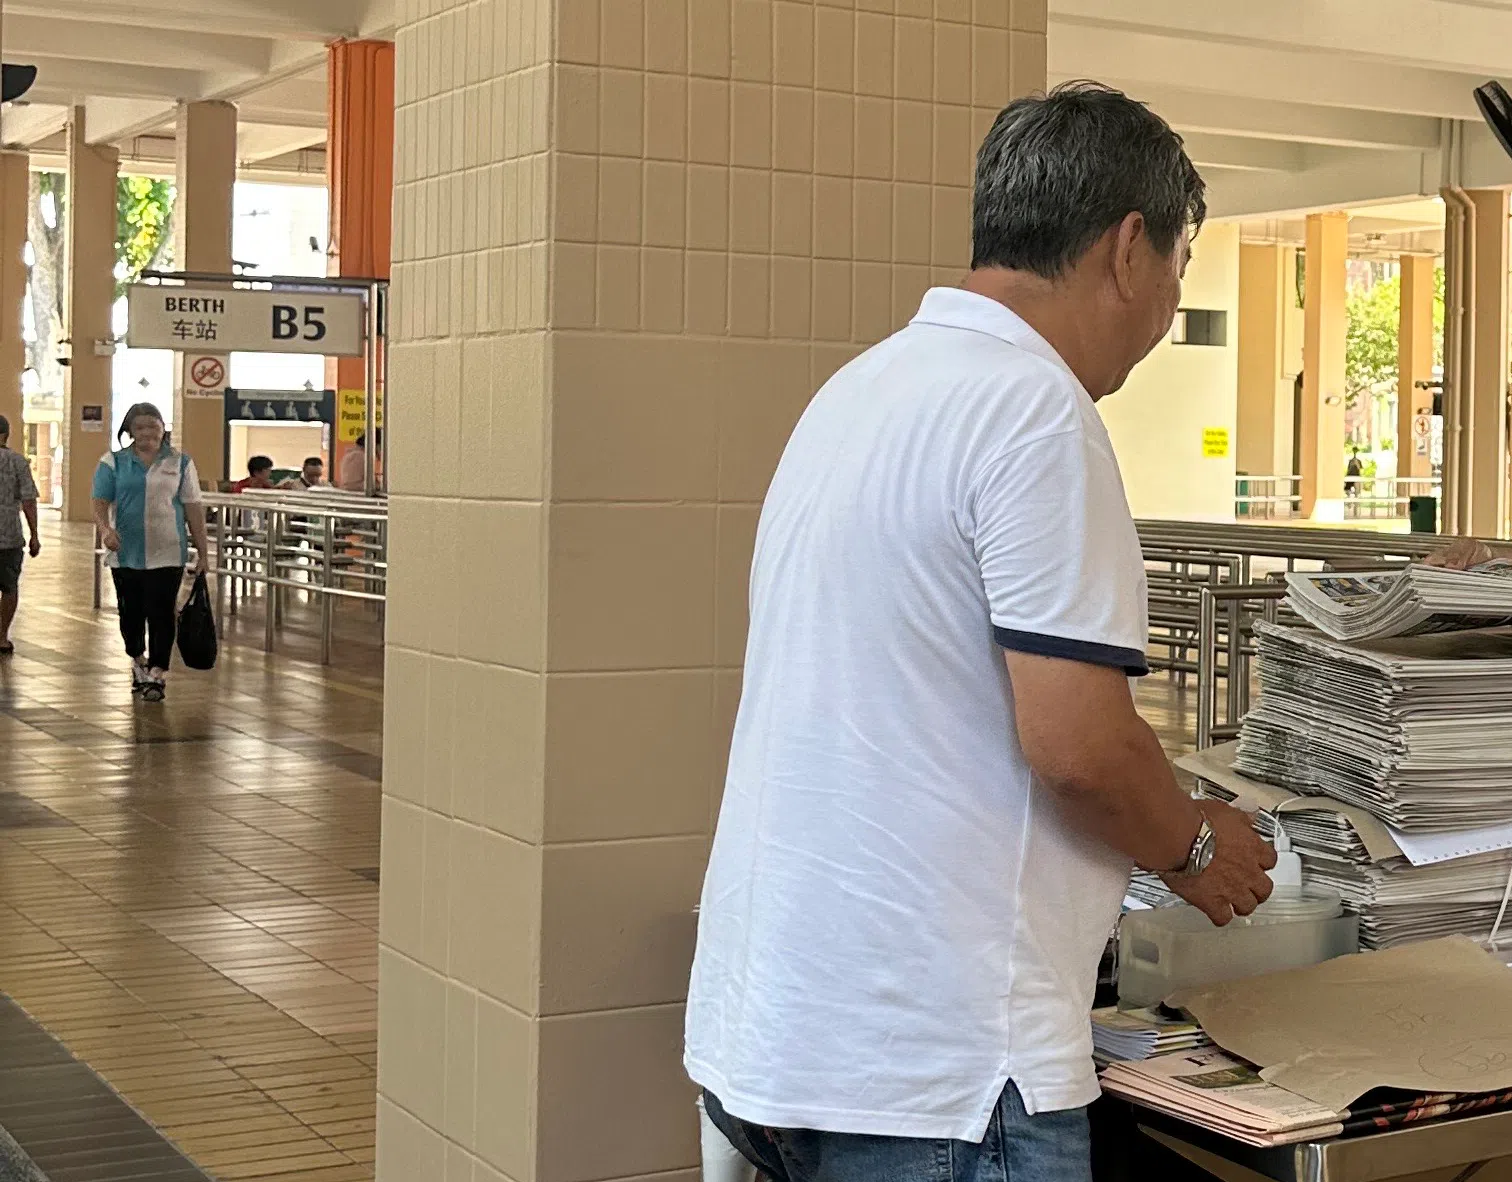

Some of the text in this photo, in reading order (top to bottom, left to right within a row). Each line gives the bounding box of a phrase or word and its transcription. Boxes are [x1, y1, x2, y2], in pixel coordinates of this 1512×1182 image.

[165, 297, 224, 313] BERTH
[172, 319, 218, 341] 车站
[272, 305, 327, 341] B5
